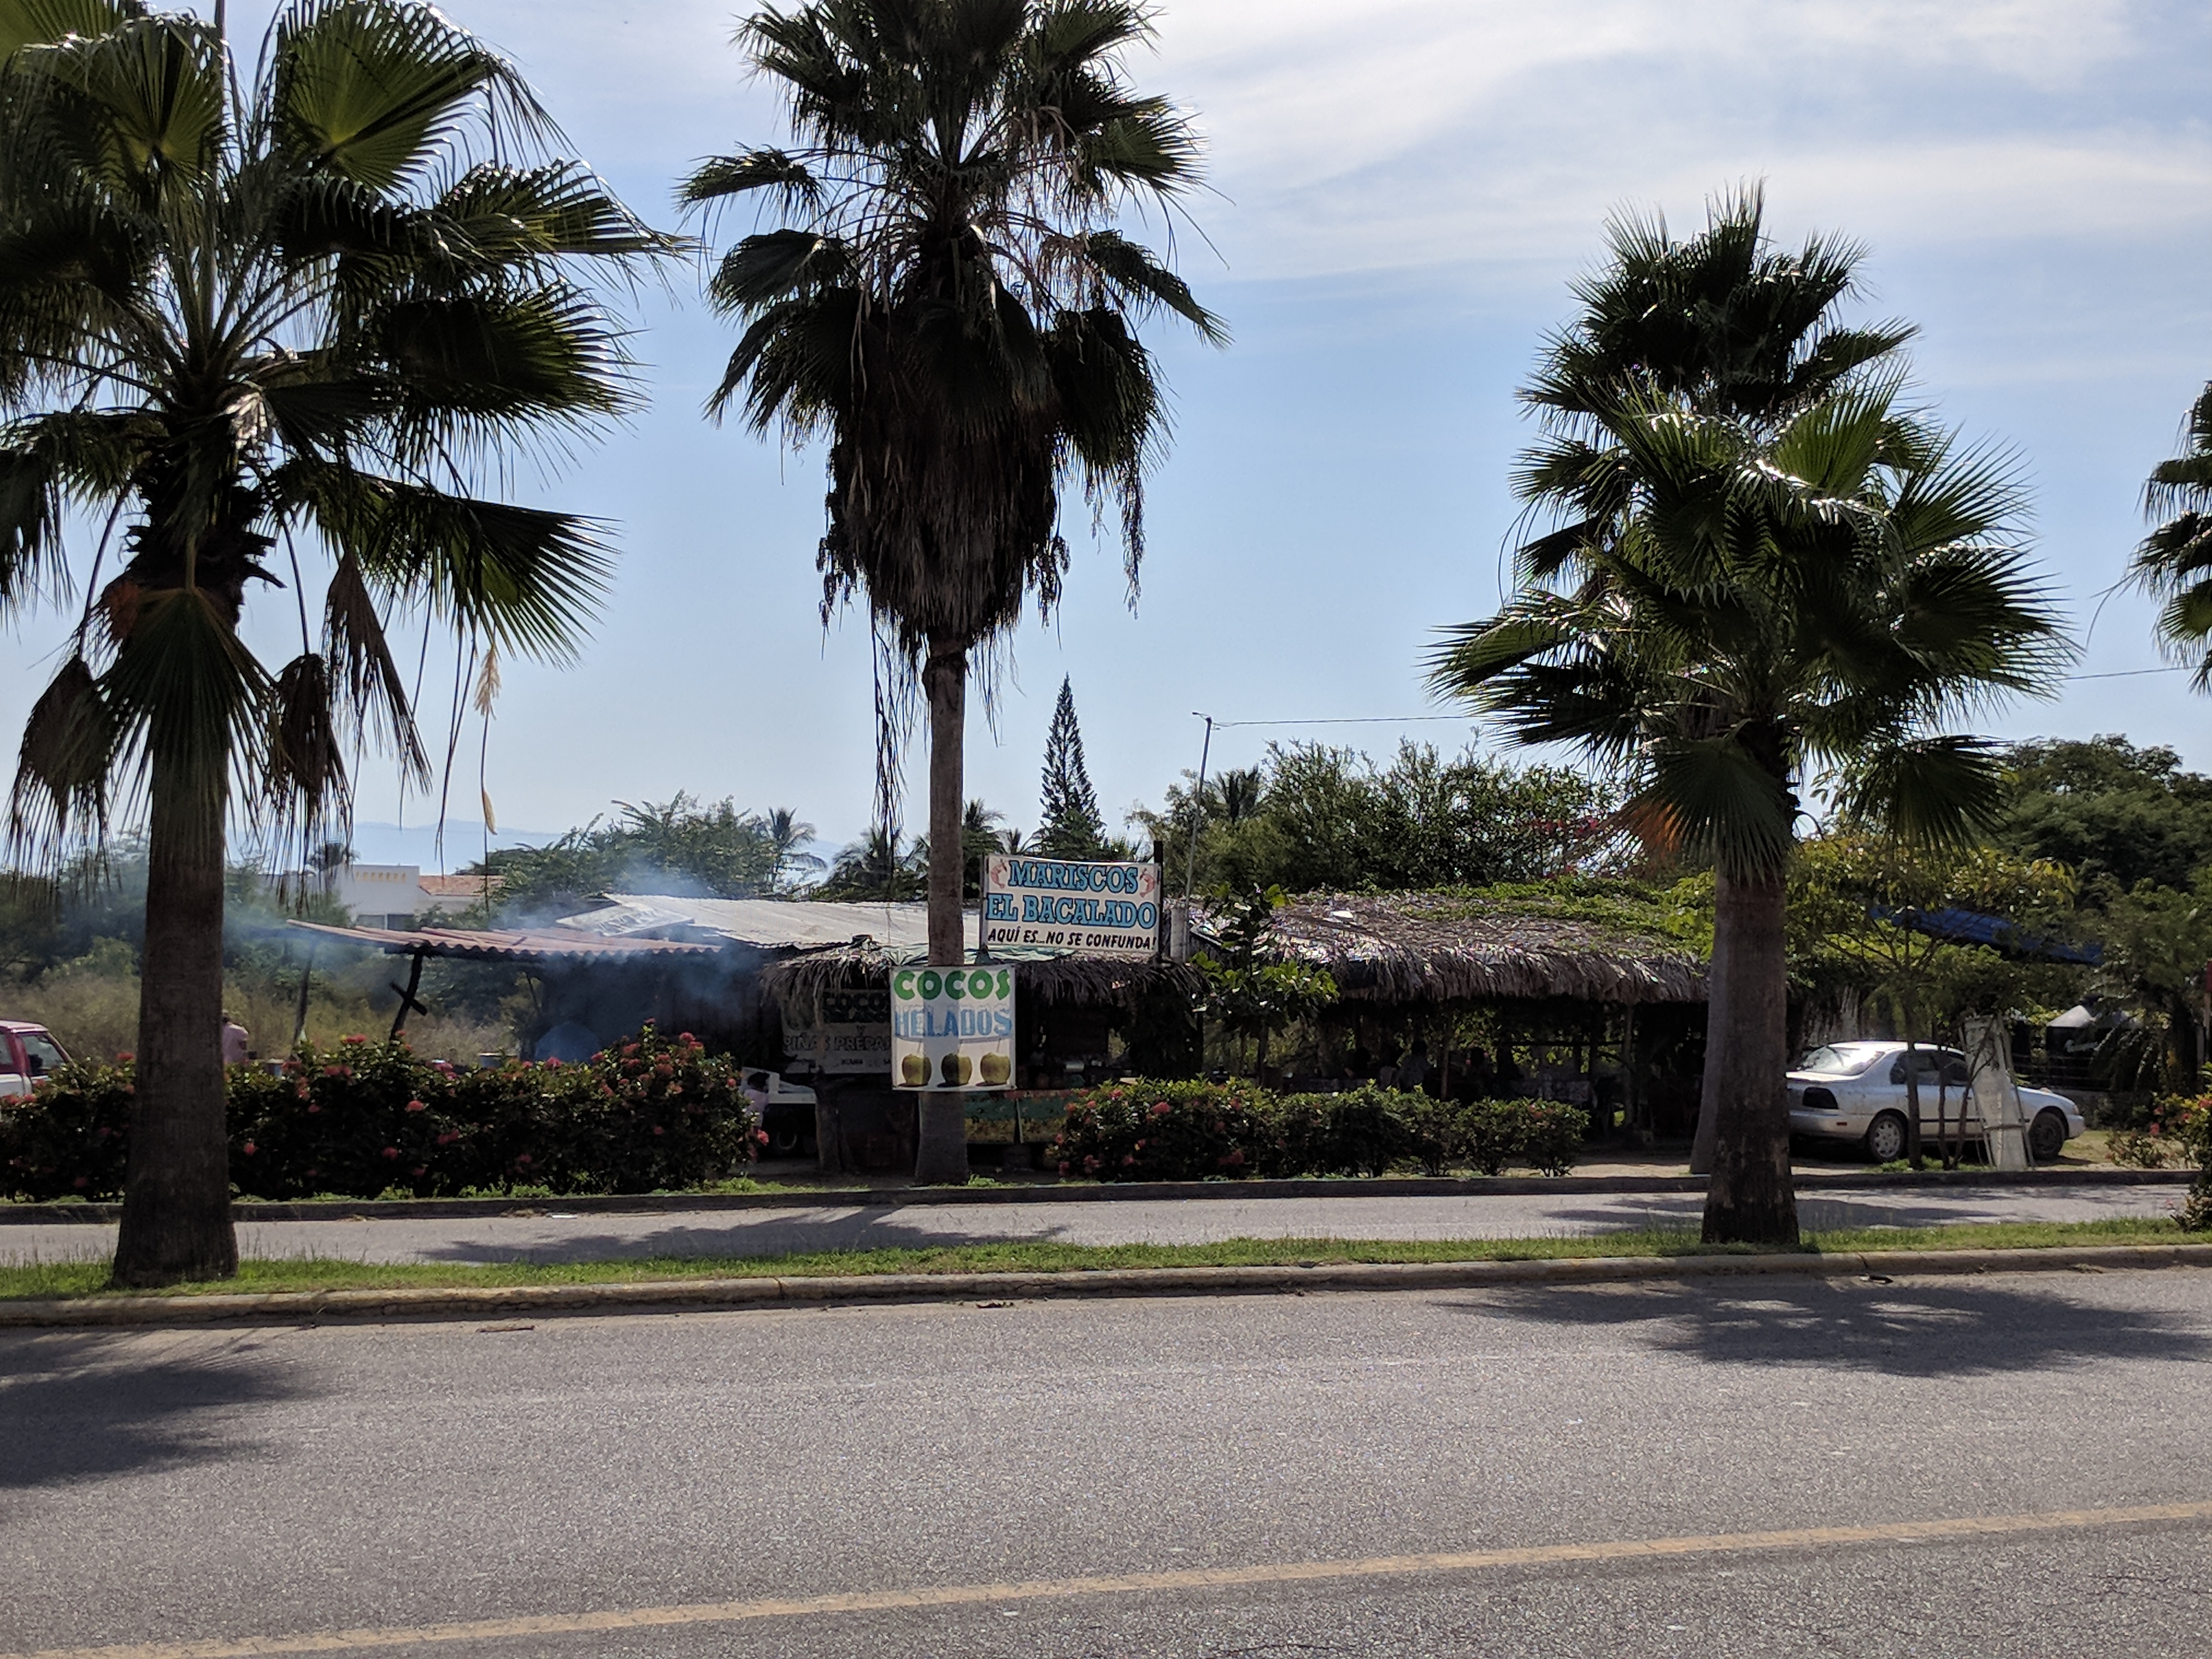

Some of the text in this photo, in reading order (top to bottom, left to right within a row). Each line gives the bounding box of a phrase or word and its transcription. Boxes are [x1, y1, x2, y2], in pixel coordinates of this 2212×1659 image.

[1008, 860, 1138, 893] MARISCOS
[986, 892, 1157, 929] EL BACALADO
[1067, 932, 1083, 946] SE
[1086, 933, 1157, 950] CONFUNDA!
[893, 969, 1010, 1000] COCOS
[895, 1004, 1013, 1037] HELADOS
